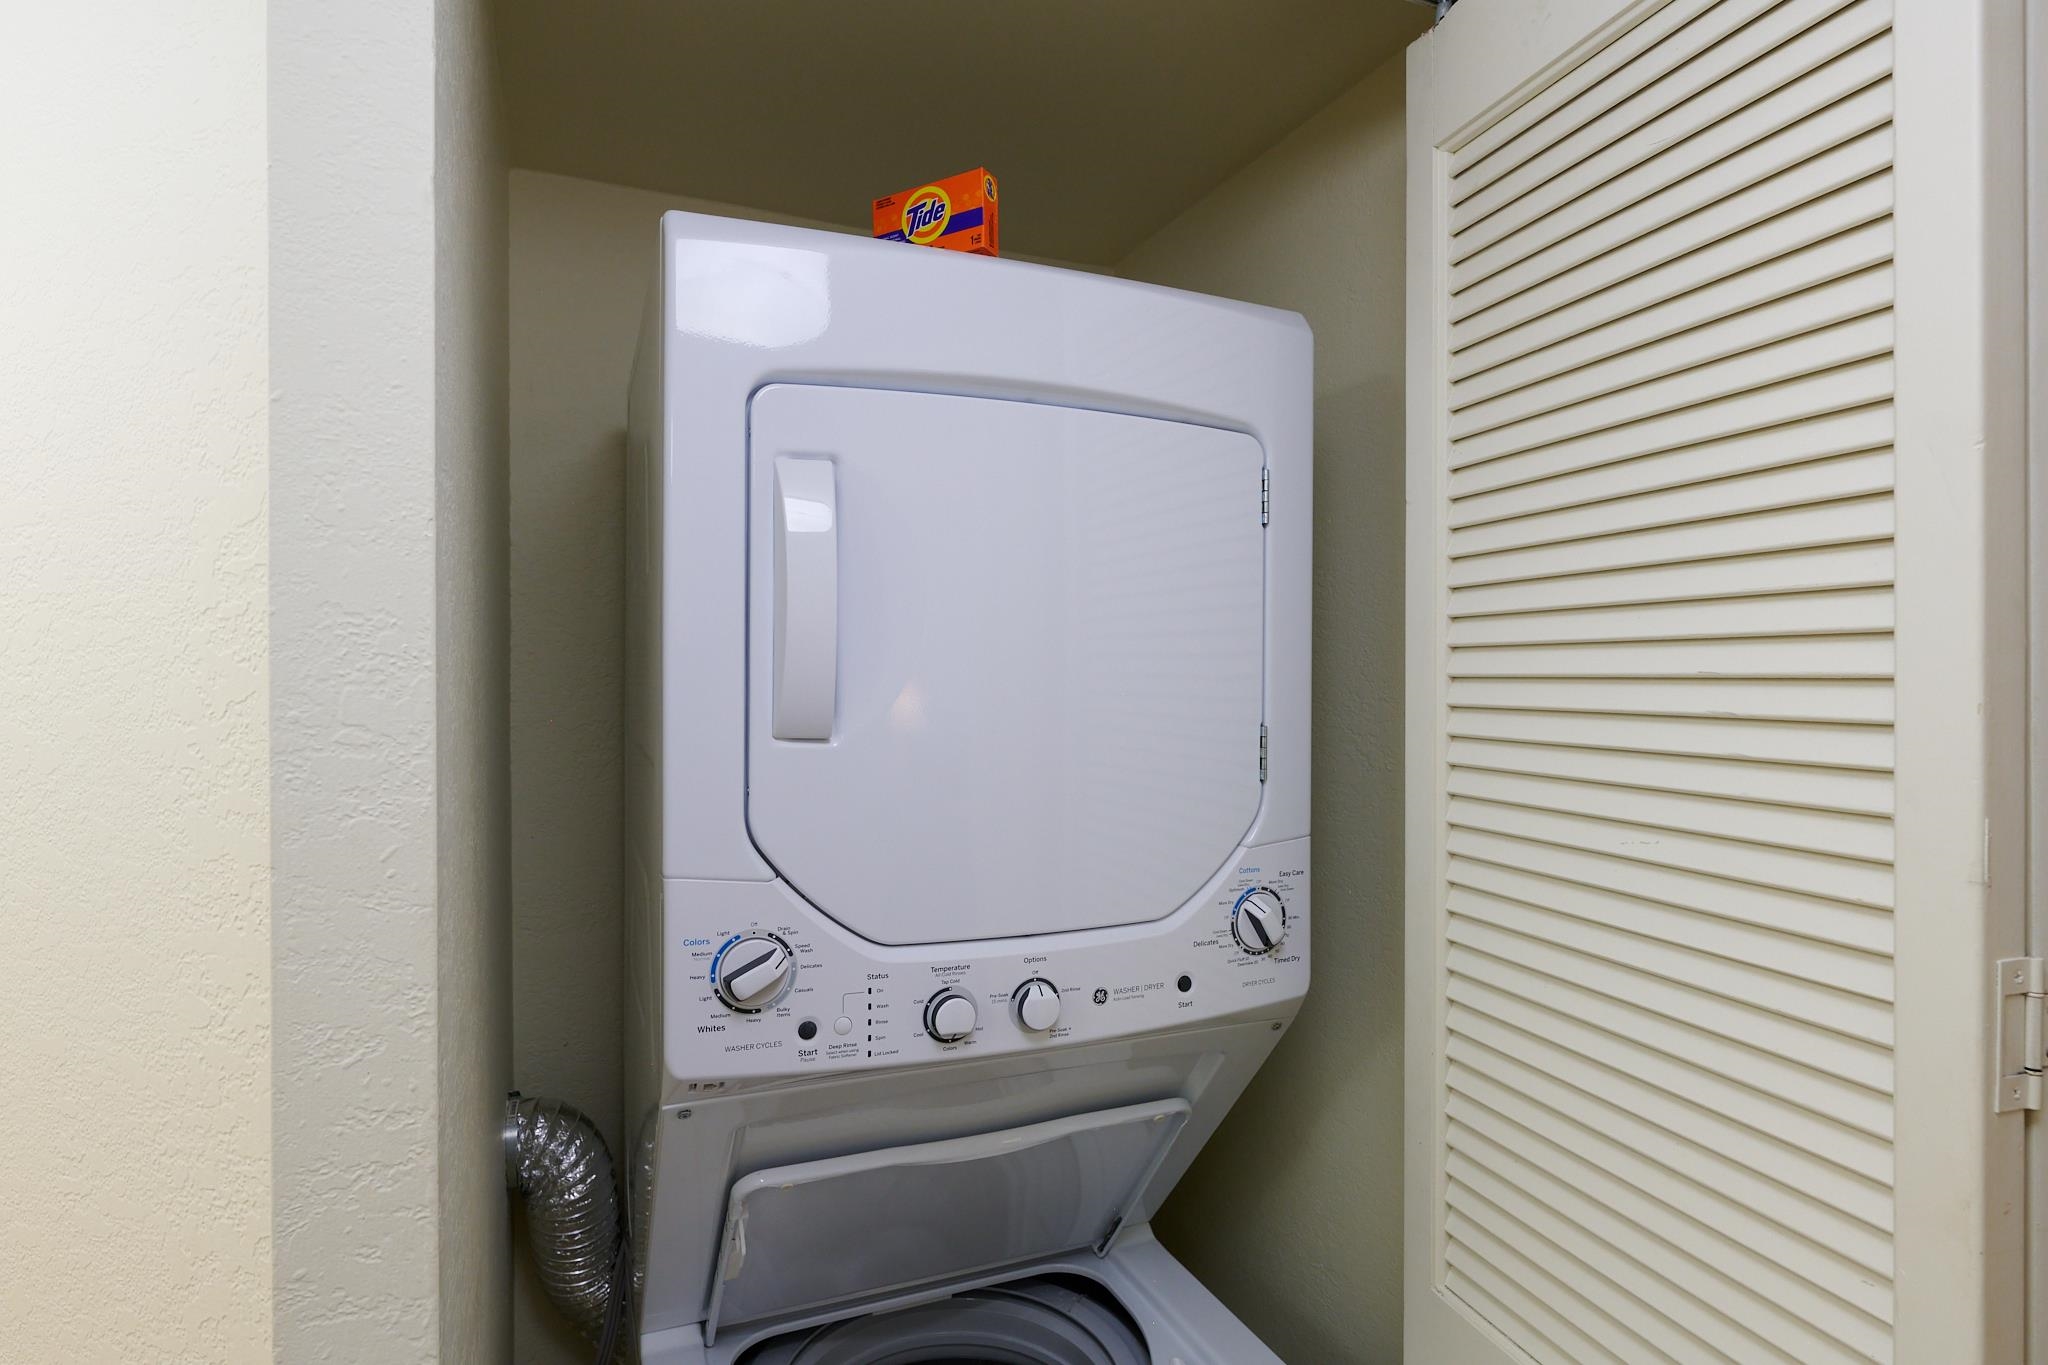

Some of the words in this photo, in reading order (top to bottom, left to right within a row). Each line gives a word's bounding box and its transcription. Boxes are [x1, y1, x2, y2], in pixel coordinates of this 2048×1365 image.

[906, 197, 946, 239] Tide
[683, 938, 711, 946] Colors
[1193, 939, 1219, 948] Delicates
[1023, 956, 1047, 965] Options
[1291, 955, 1301, 963] Dry
[930, 964, 971, 974] Temperature
[867, 973, 889, 981] Status
[1113, 986, 1140, 995] WASHER
[1144, 982, 1165, 991] DRYER
[697, 1025, 726, 1033] Whites
[724, 1043, 755, 1052] WASHER
[756, 1040, 783, 1050] CYCLES
[798, 1049, 818, 1057] Start
